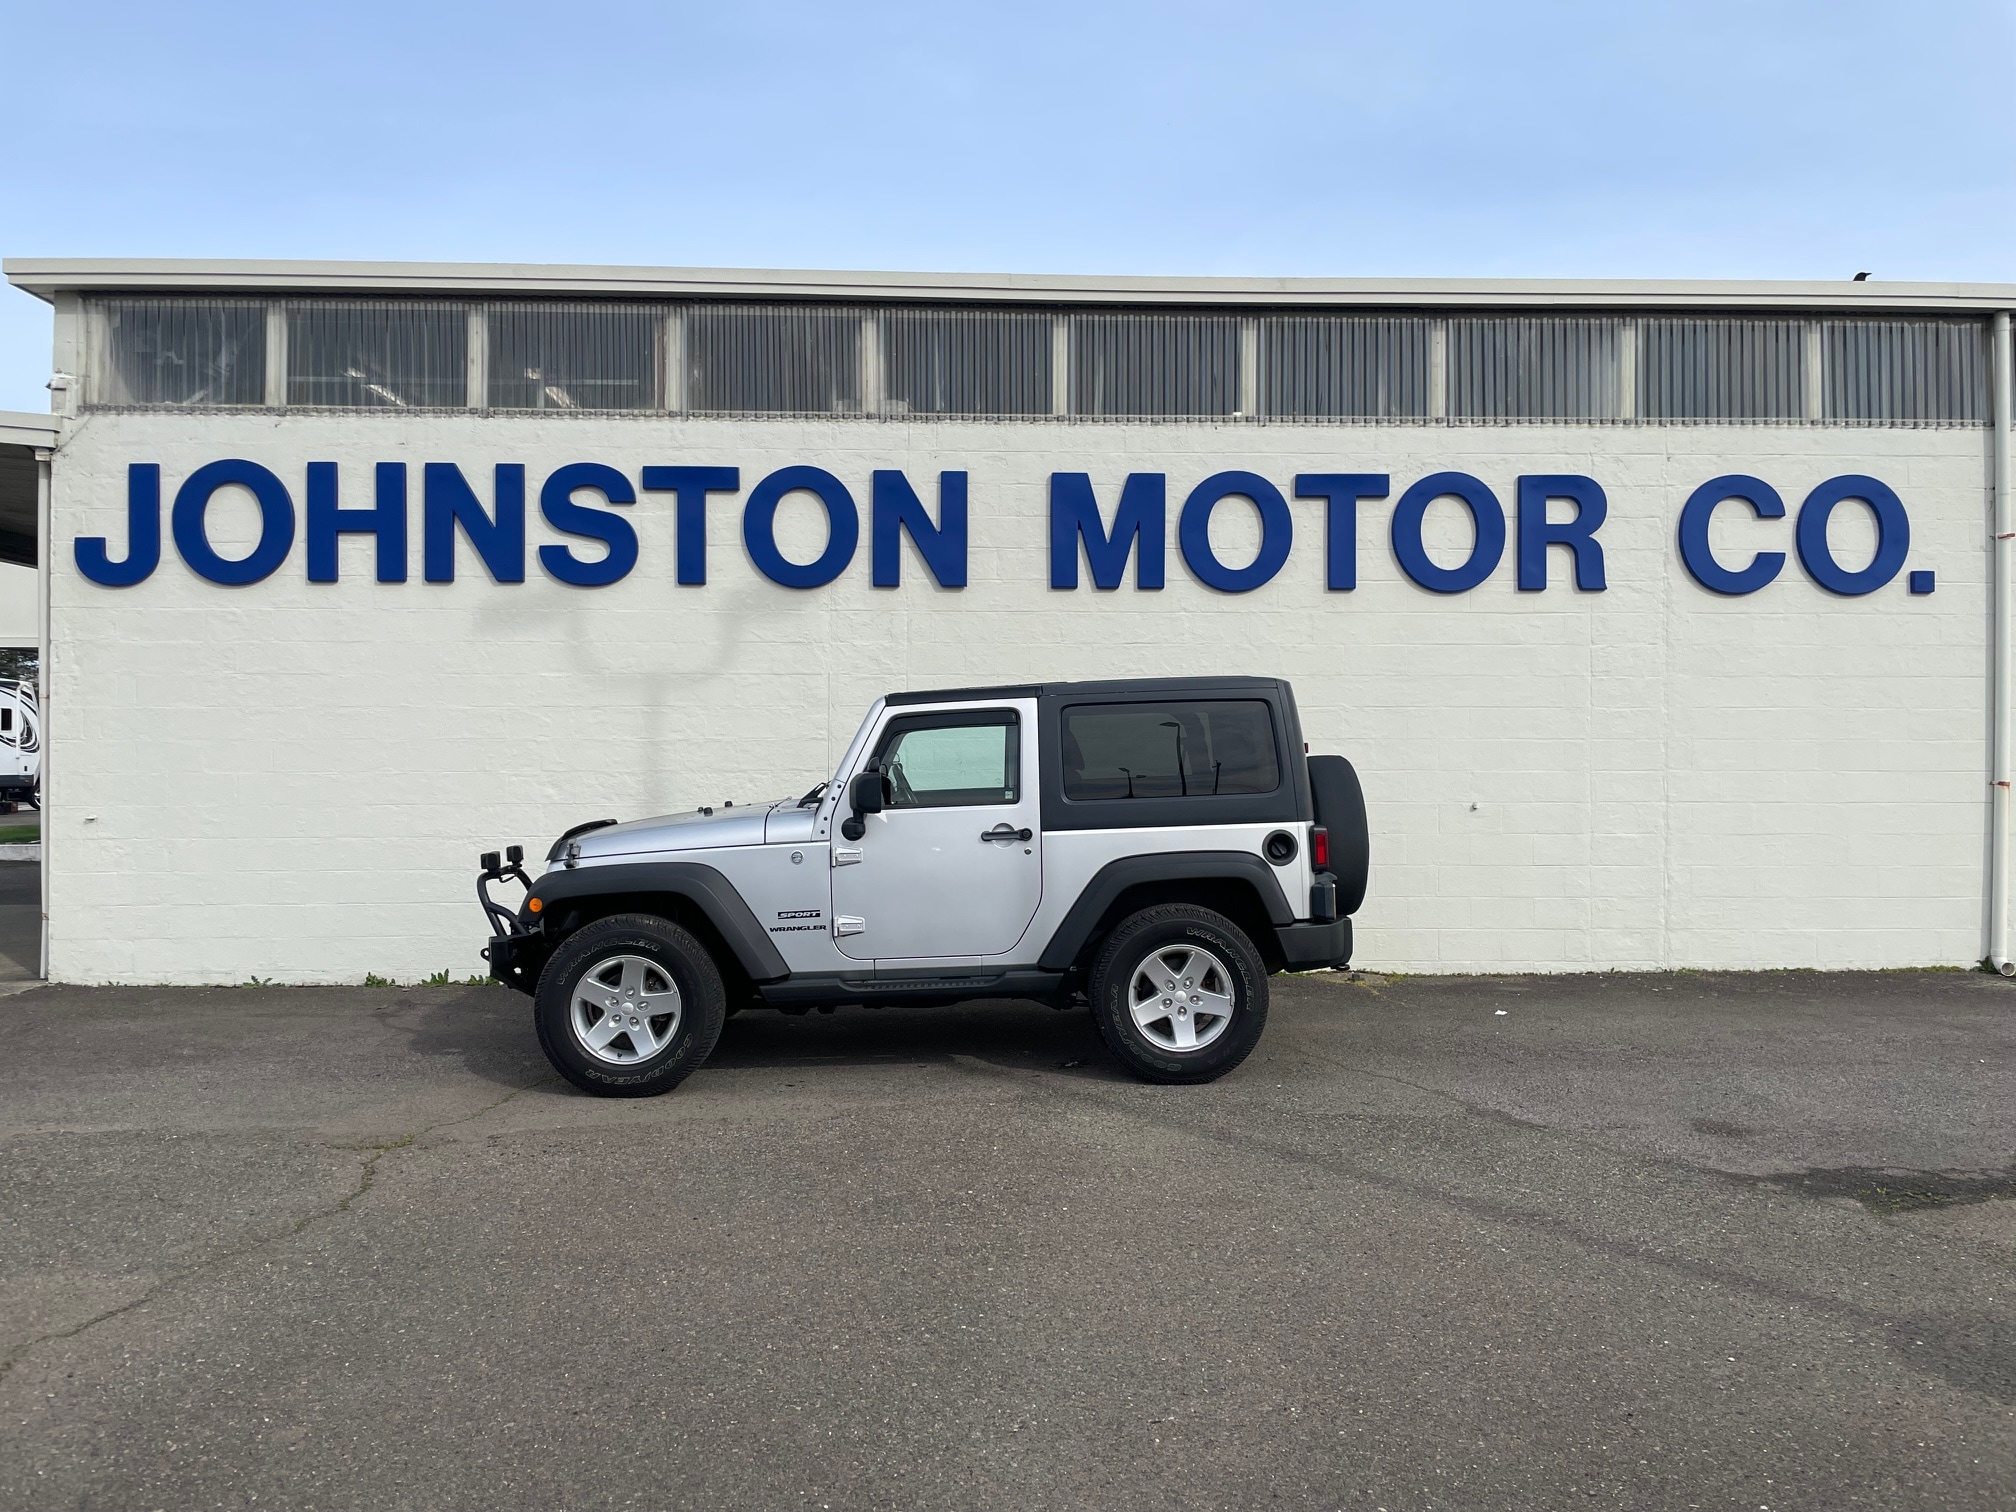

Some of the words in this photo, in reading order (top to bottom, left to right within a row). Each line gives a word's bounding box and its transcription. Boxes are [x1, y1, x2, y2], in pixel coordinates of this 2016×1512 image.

[75, 460, 968, 588] JOHNSTON
[1051, 470, 1606, 592] MOTOR
[1680, 474, 1935, 595] CO.
[769, 924, 827, 933] WRANGLER
[778, 911, 818, 919] SPORT
[556, 936, 662, 986] WRANGLER
[1186, 926, 1254, 1012] WRANGLER
[1109, 983, 1183, 1072] GOODYEAR
[585, 1032, 694, 1085] GOODYEAR
